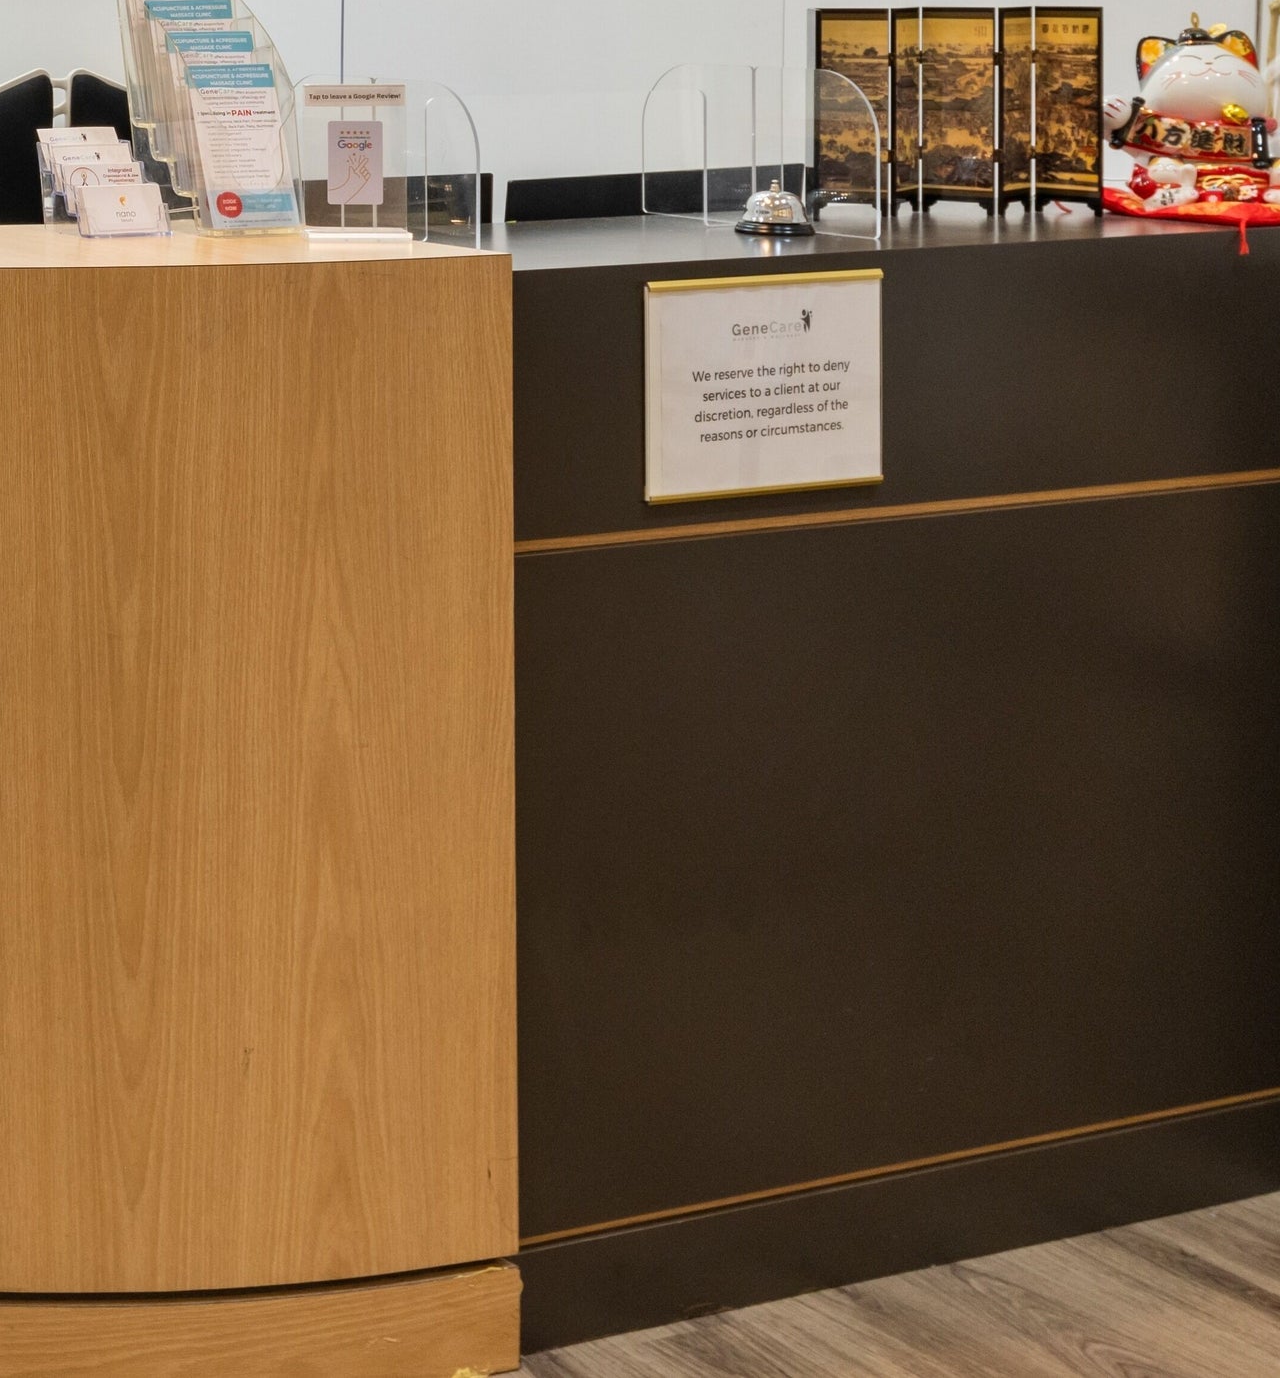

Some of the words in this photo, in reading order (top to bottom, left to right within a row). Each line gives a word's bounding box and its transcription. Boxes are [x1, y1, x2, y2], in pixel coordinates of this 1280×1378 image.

[309, 93, 320, 101] Tap
[353, 93, 375, 101] Google
[337, 139, 373, 151] Google
[116, 210, 137, 218] nano
[732, 322, 802, 337] GeneCare
[692, 371, 711, 382] We
[714, 368, 754, 381] reserve
[757, 365, 776, 377] the
[779, 362, 805, 377] right
[809, 362, 821, 373] to
[823, 359, 850, 373] deny
[702, 388, 747, 402] services
[750, 387, 762, 398] to
[764, 386, 771, 396] a
[774, 382, 805, 396] client
[808, 381, 820, 393] at
[822, 380, 841, 392] our
[694, 407, 754, 423] discretion,
[757, 402, 814, 419] regardless
[817, 400, 829, 413] of
[831, 398, 849, 410] the
[700, 428, 743, 443] reasons
[745, 427, 758, 438] or
[760, 420, 845, 437] circumstances.
